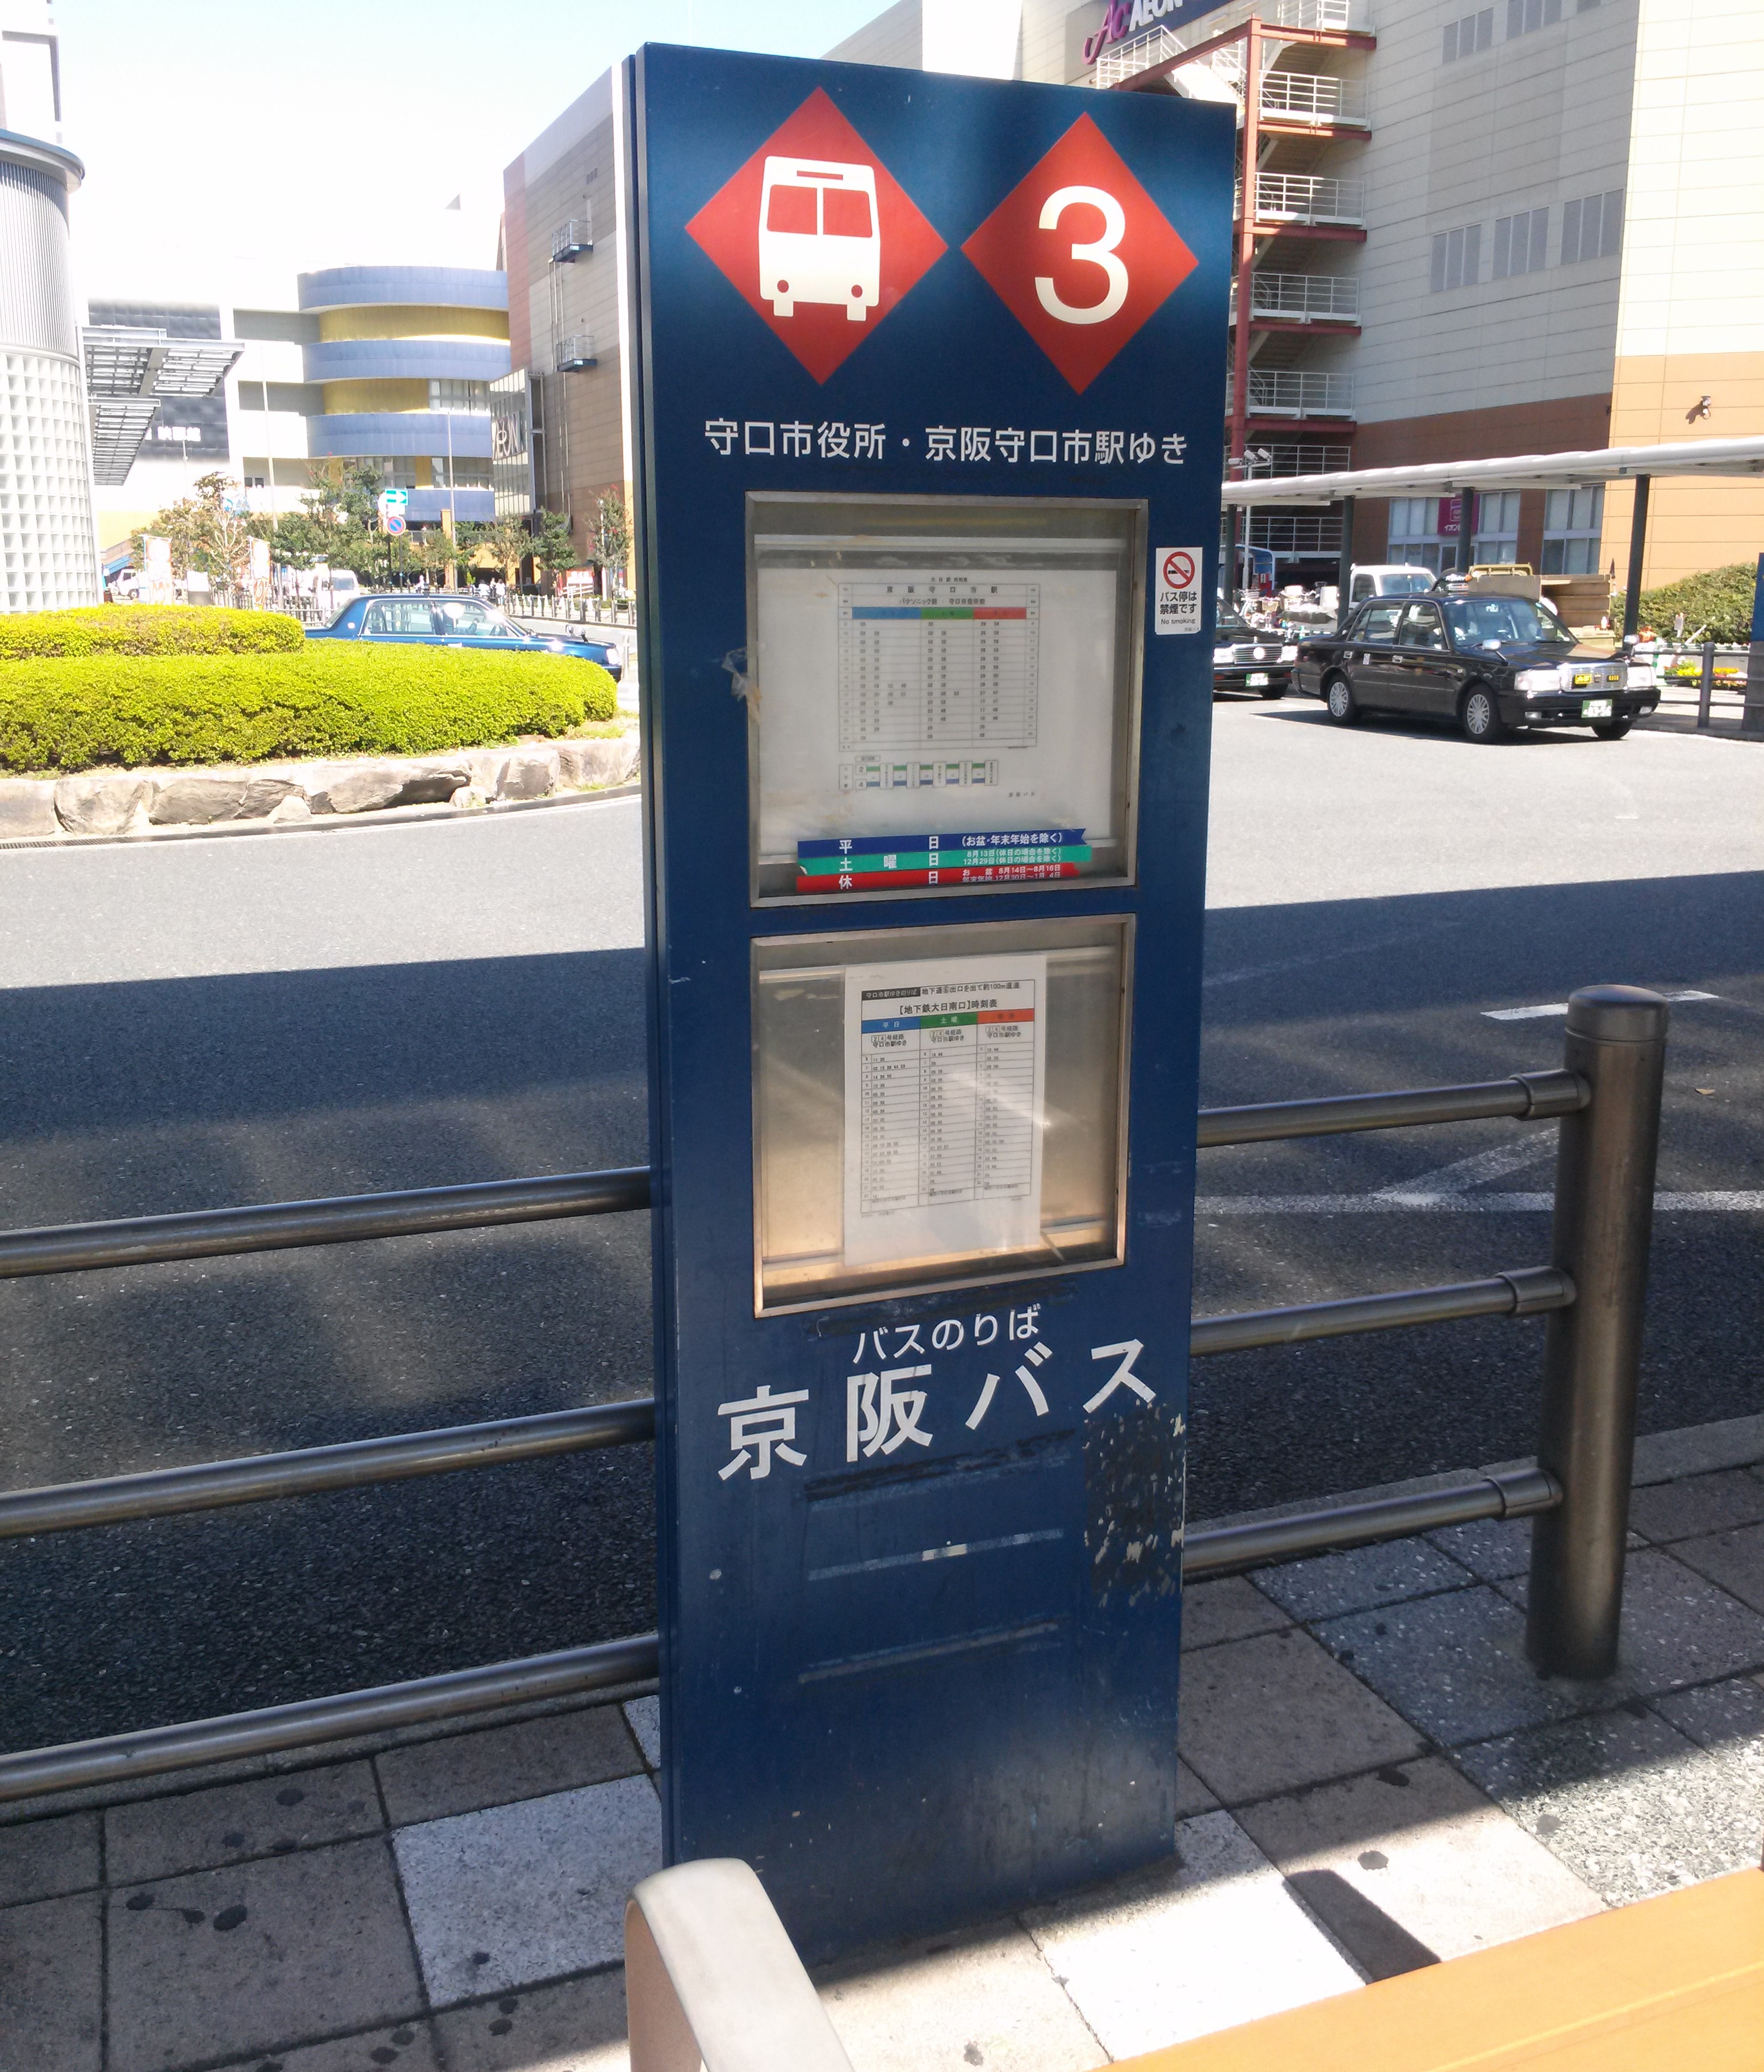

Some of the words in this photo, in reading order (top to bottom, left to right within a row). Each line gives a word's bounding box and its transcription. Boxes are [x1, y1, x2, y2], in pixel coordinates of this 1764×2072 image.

[1034, 185, 1129, 325] 3
[1160, 591, 1197, 602] バス停は
[1160, 604, 1197, 615] 禁煙です
[866, 988, 916, 998] 守口市駅ゆきのりば
[853, 1303, 1042, 1364] バスのりば
[718, 1338, 1156, 1481] 京阪バス
